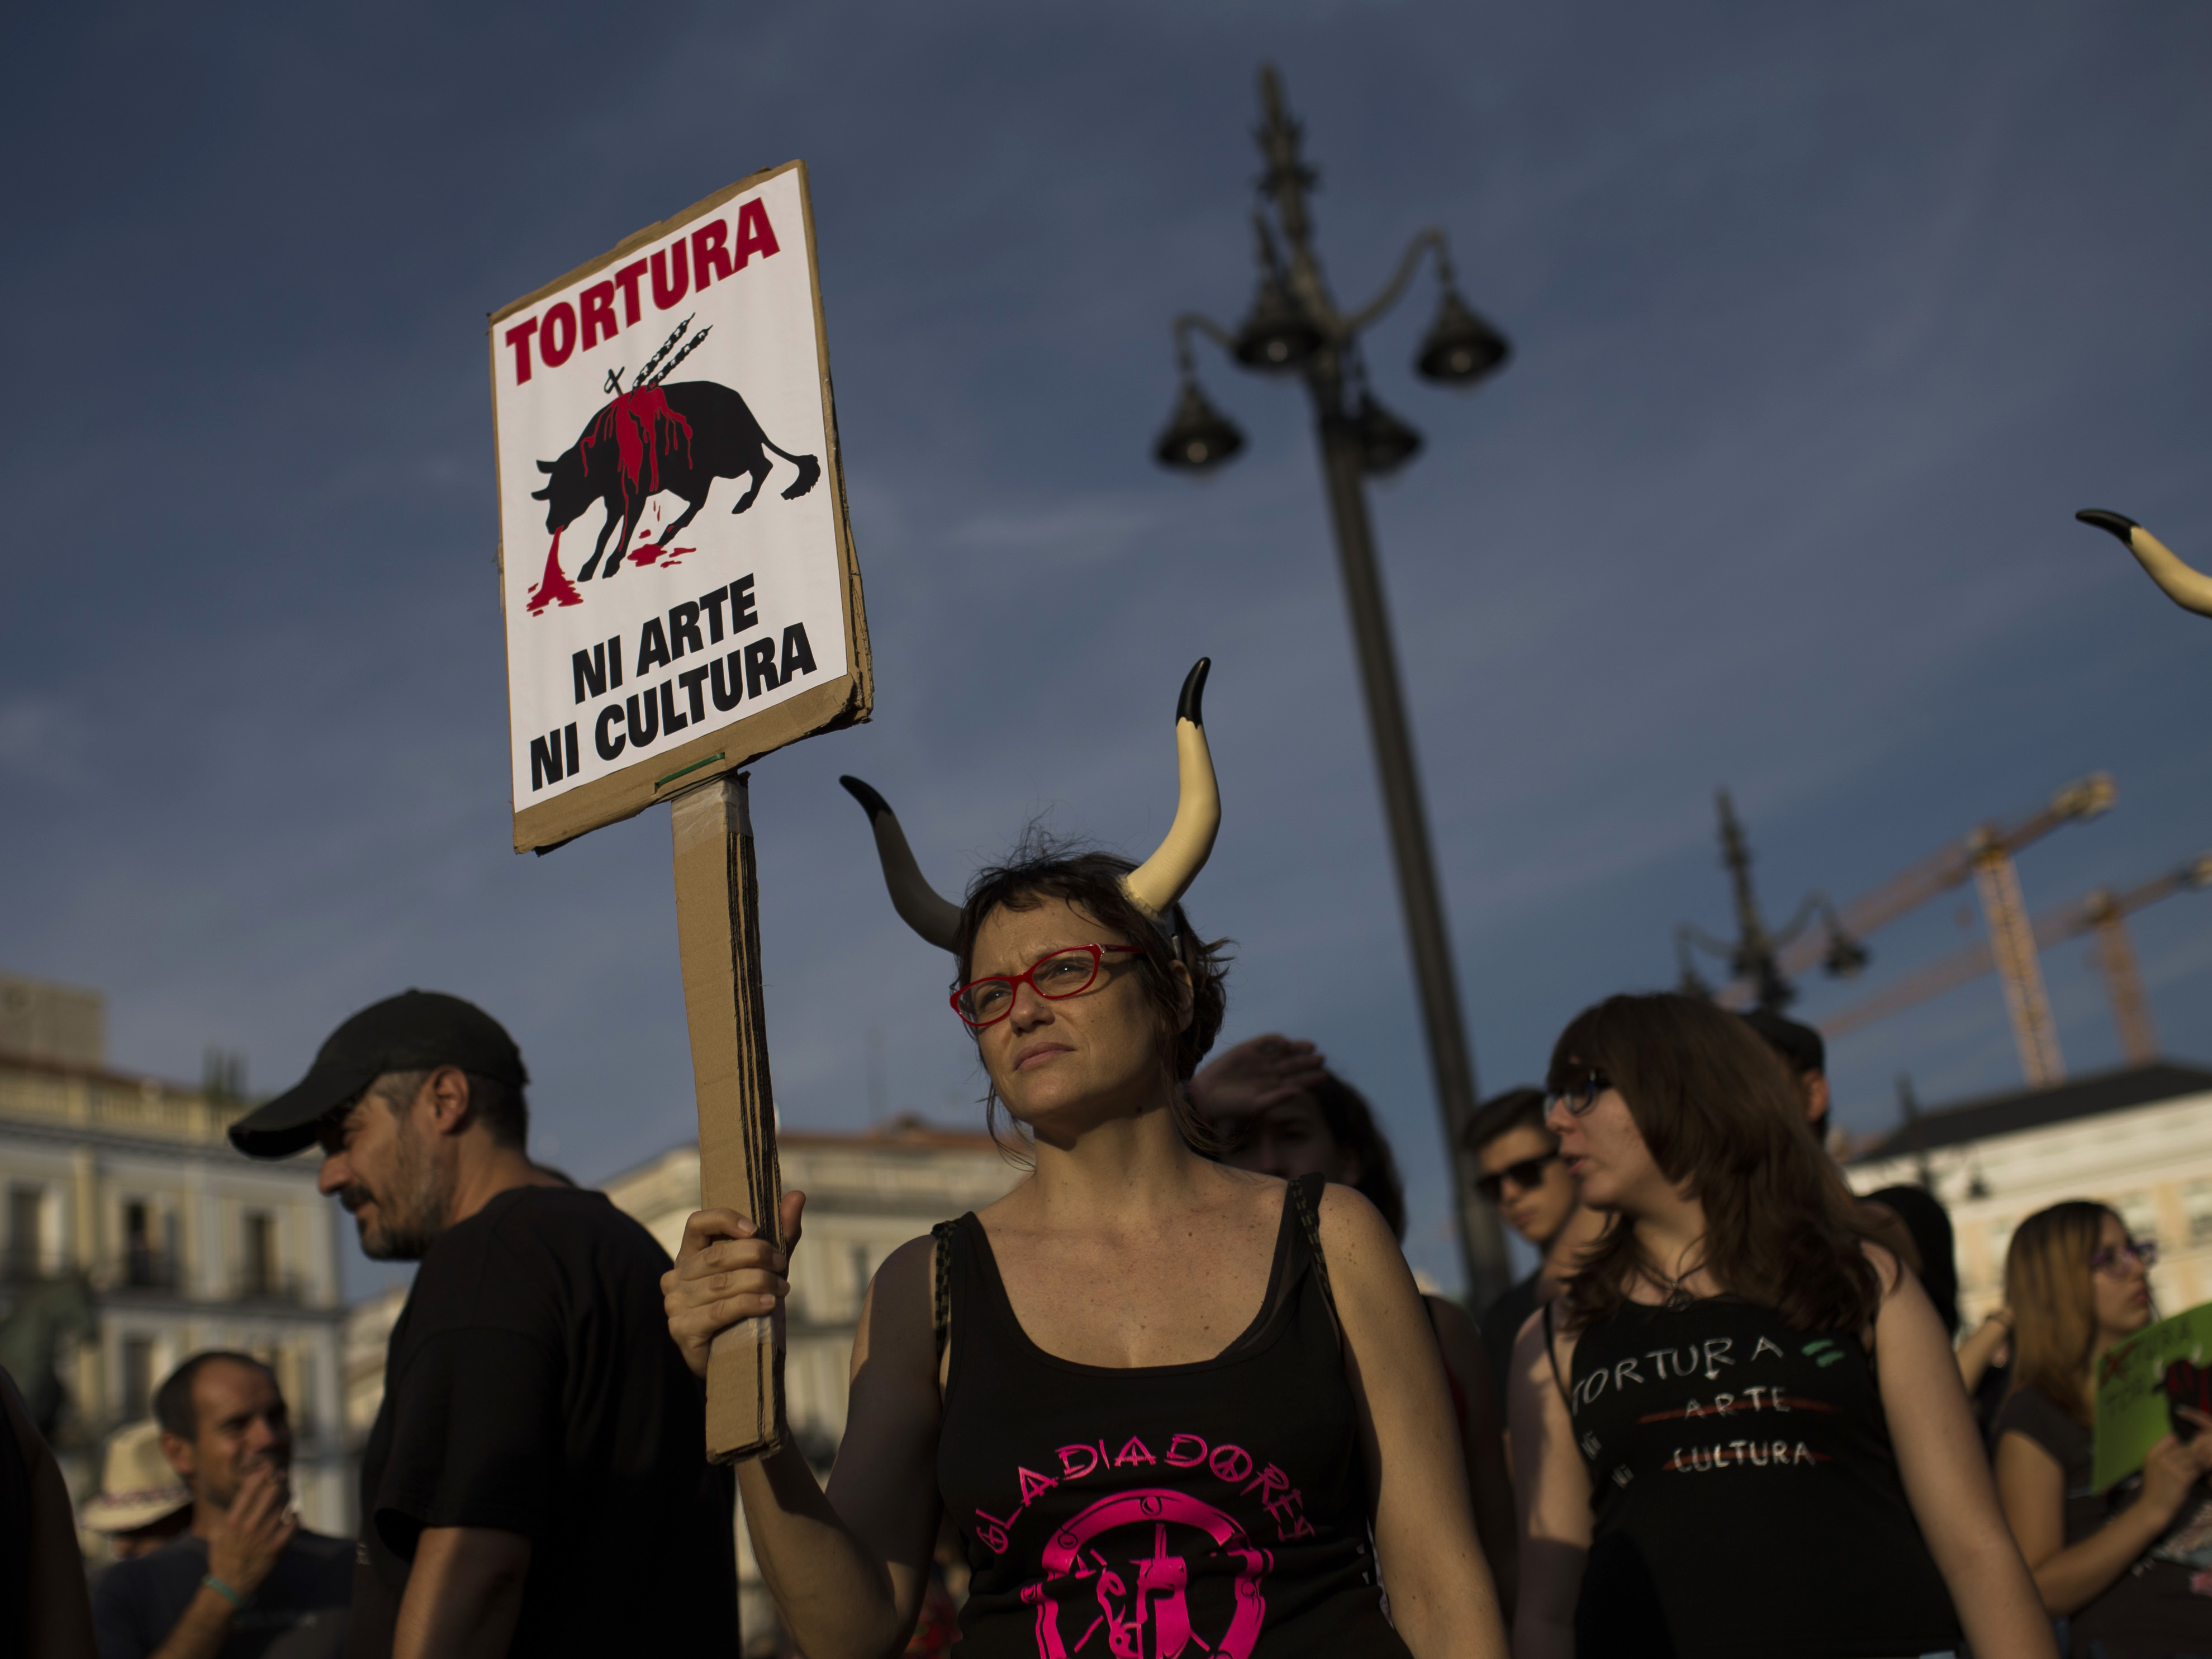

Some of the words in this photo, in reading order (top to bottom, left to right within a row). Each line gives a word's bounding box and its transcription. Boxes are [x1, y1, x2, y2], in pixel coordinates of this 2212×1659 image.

[505, 197, 780, 386] TORTURA
[572, 635, 623, 705] NI
[636, 572, 758, 677] ARTE
[530, 722, 580, 792] NI
[595, 622, 818, 761] CULTURA
[1572, 1335, 1784, 1417] TORTURA
[1684, 1385, 1791, 1420] ARTE
[1673, 1439, 1816, 1473] CULTURA
